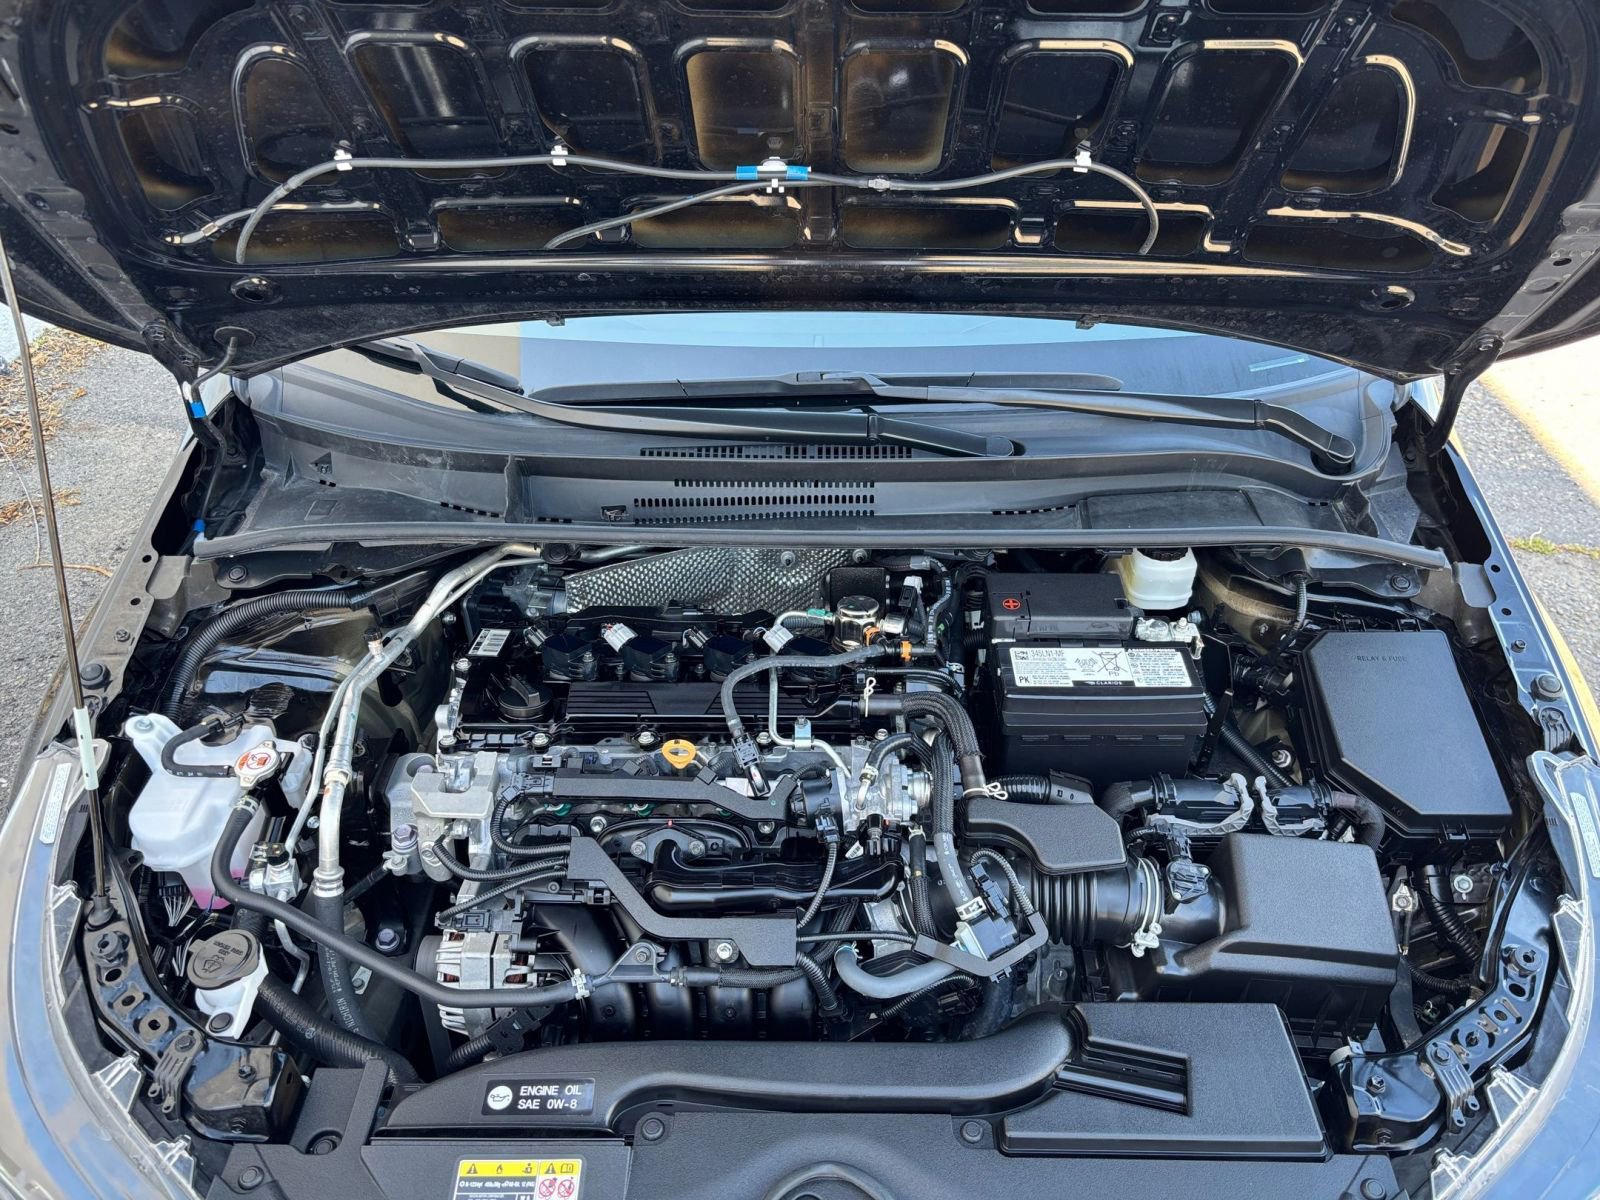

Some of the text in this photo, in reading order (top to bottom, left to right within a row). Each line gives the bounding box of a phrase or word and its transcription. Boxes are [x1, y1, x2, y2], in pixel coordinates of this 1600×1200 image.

[336, 997, 355, 1028] NICHIRIN
[519, 1084, 583, 1096] ENGINE OIL
[516, 1098, 578, 1110] SAE 0W-8
